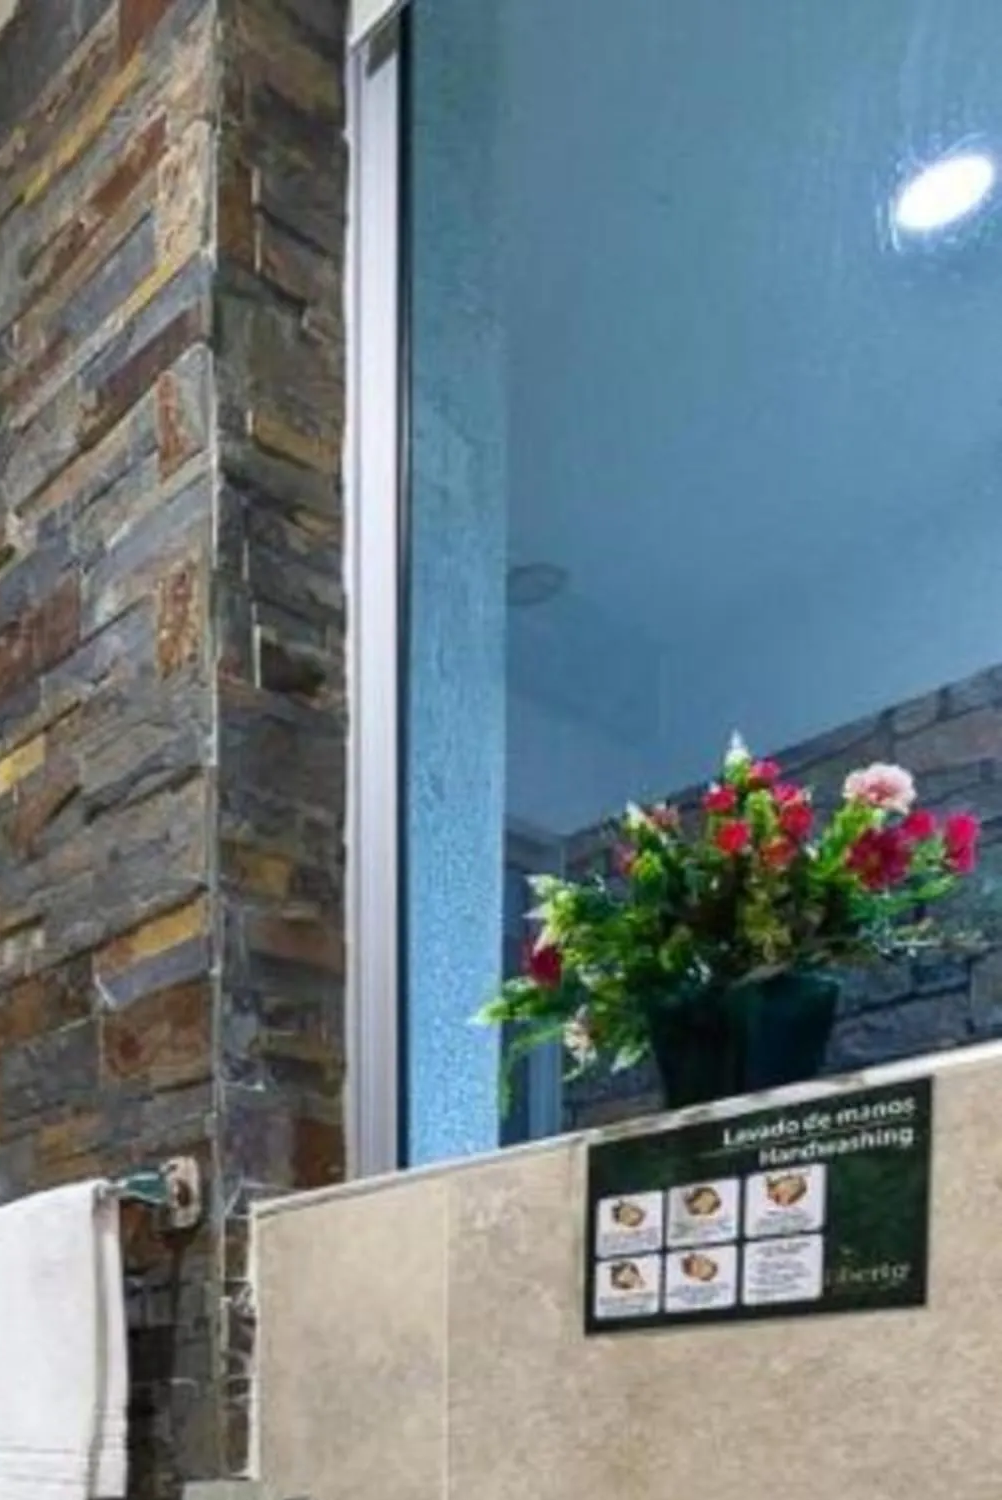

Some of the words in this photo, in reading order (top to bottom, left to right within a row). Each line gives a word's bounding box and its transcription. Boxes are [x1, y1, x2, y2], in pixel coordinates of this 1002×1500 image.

[722, 1118, 799, 1146] Lavado
[802, 1111, 832, 1131] de
[836, 1097, 916, 1125] manos
[758, 1126, 915, 1166] Handwashing
